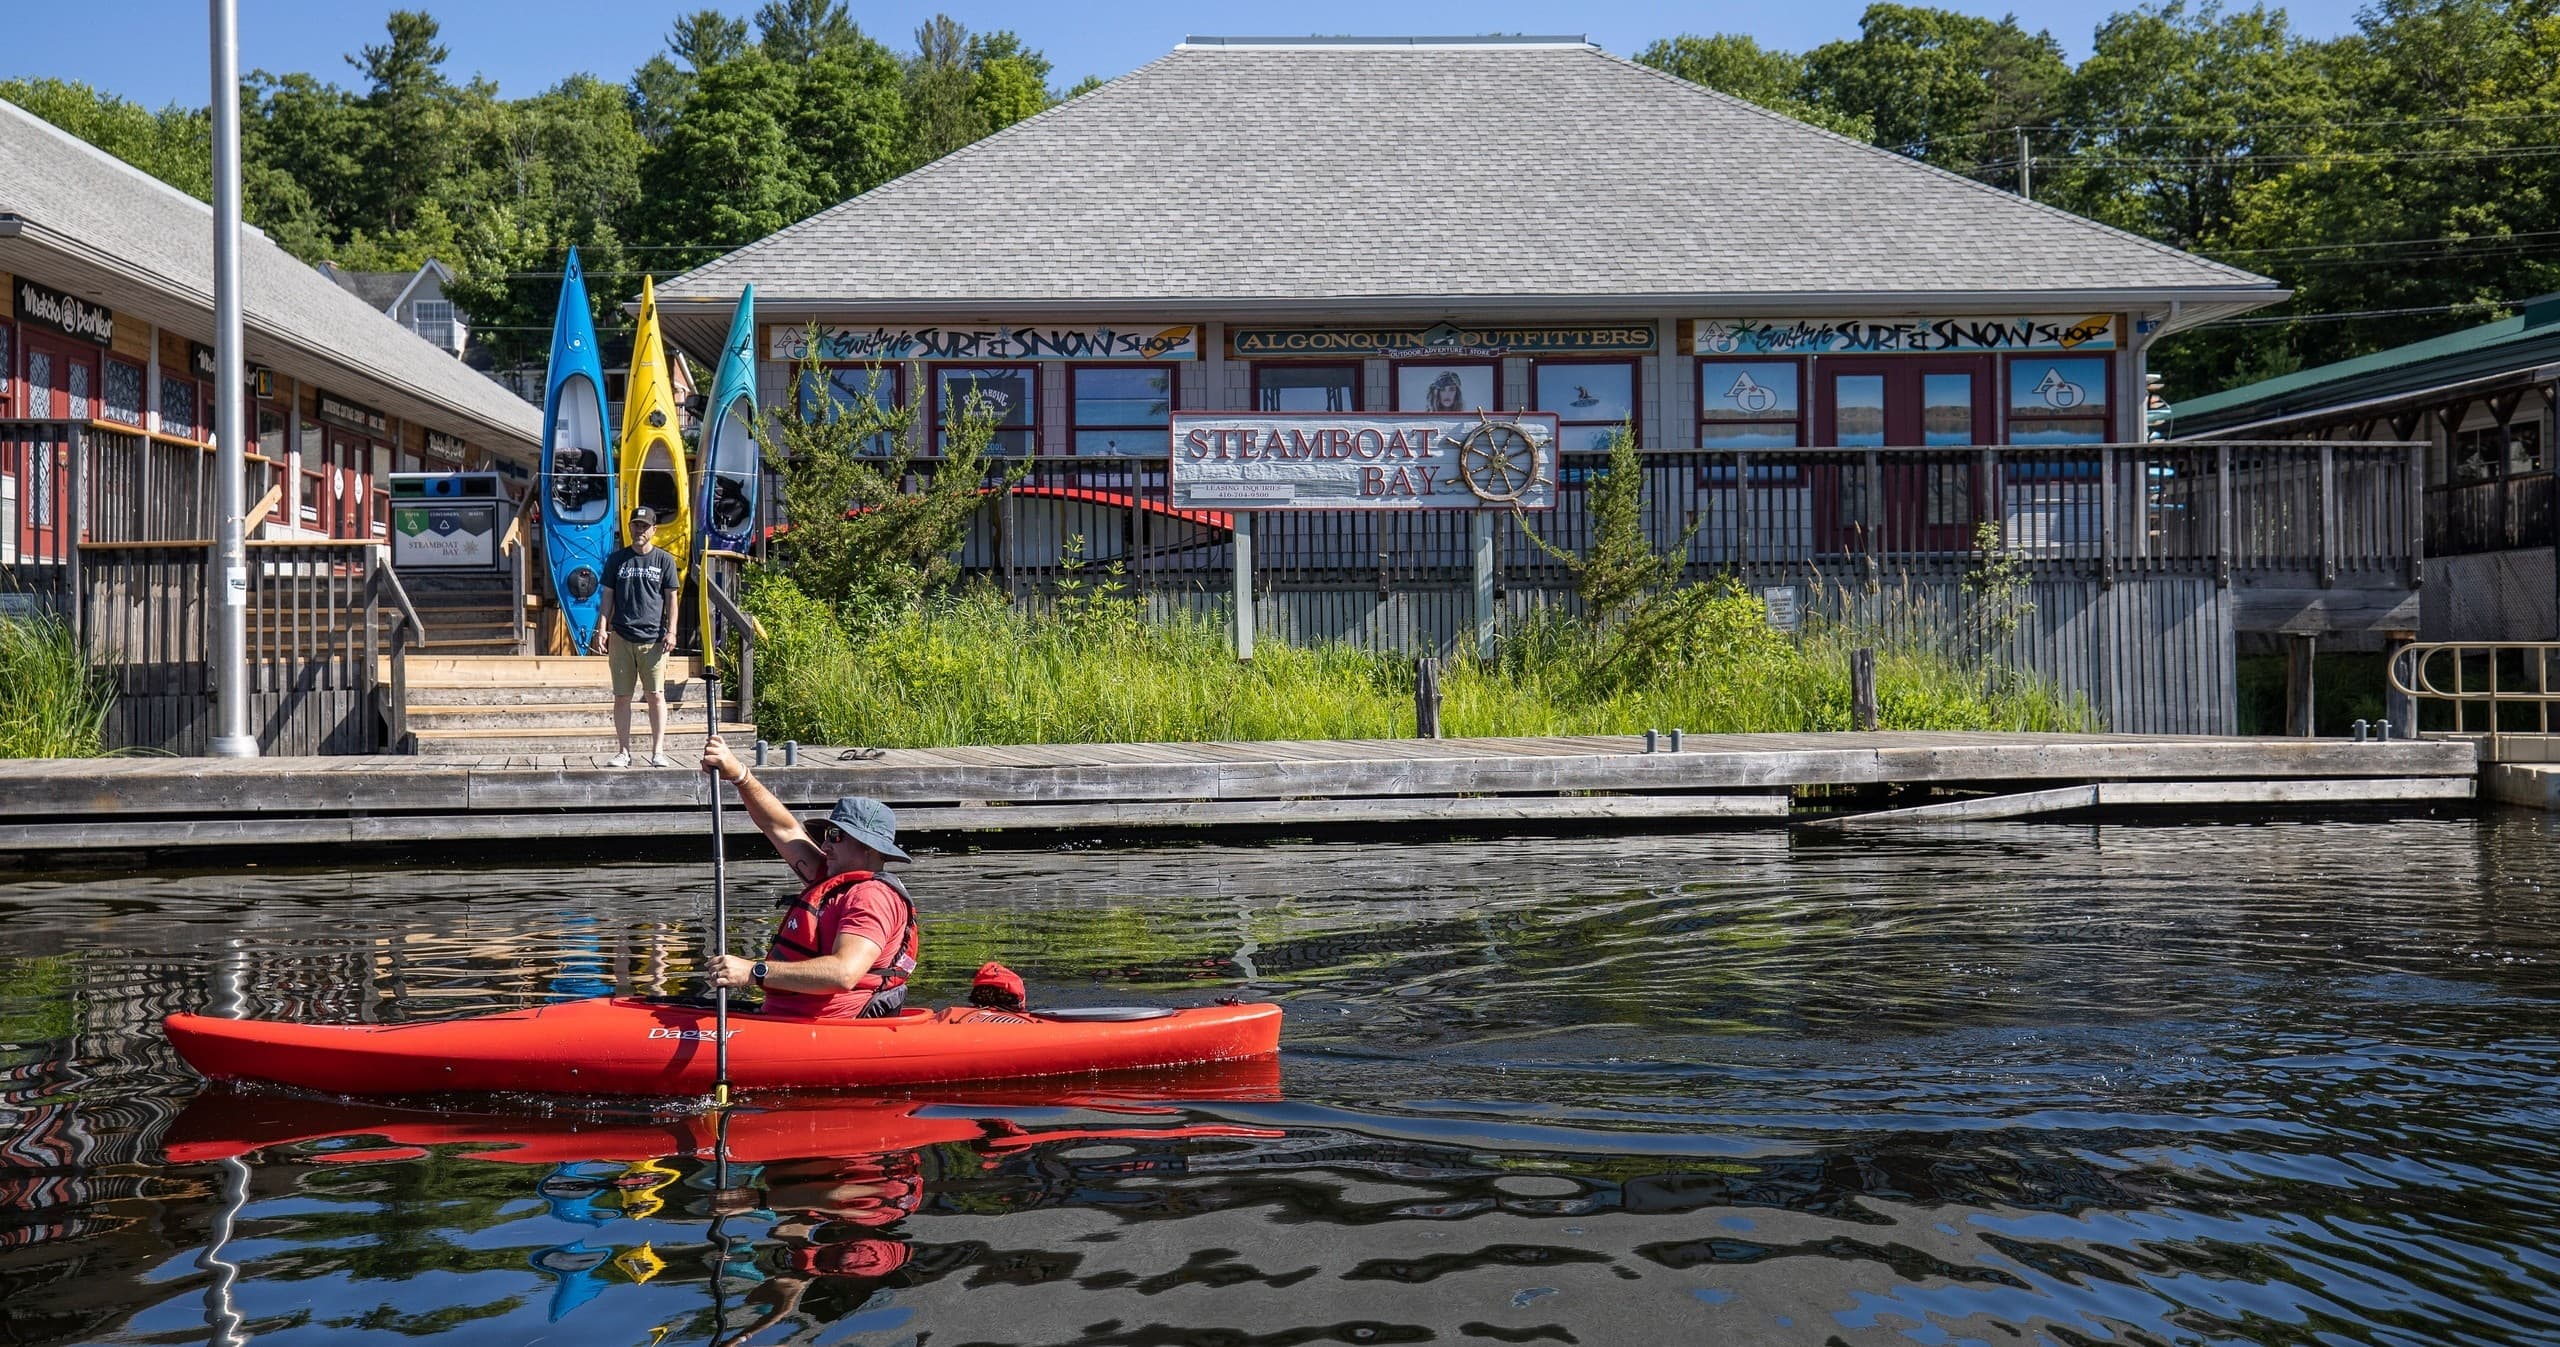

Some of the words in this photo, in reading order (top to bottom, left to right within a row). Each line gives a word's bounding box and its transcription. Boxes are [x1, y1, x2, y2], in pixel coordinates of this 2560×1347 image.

[833, 328, 913, 357] Swifty's
[915, 328, 997, 357] SURF
[1012, 327, 1116, 358] SNOW
[1241, 333, 1425, 349] ALGONQUIN
[1459, 329, 1649, 346] OUTFITTERS
[1756, 320, 1833, 350] Swifty's
[1835, 320, 1916, 350] SURF
[1931, 319, 2034, 350] SNOW
[1391, 349, 1421, 358] OUTDOOR
[1424, 346, 1463, 354] ADVENTURE
[1188, 427, 1440, 460] STEAMBOAT
[1360, 465, 1440, 497] BAY
[408, 541, 458, 549] STEAMBOAT
[442, 548, 459, 556] BAY
